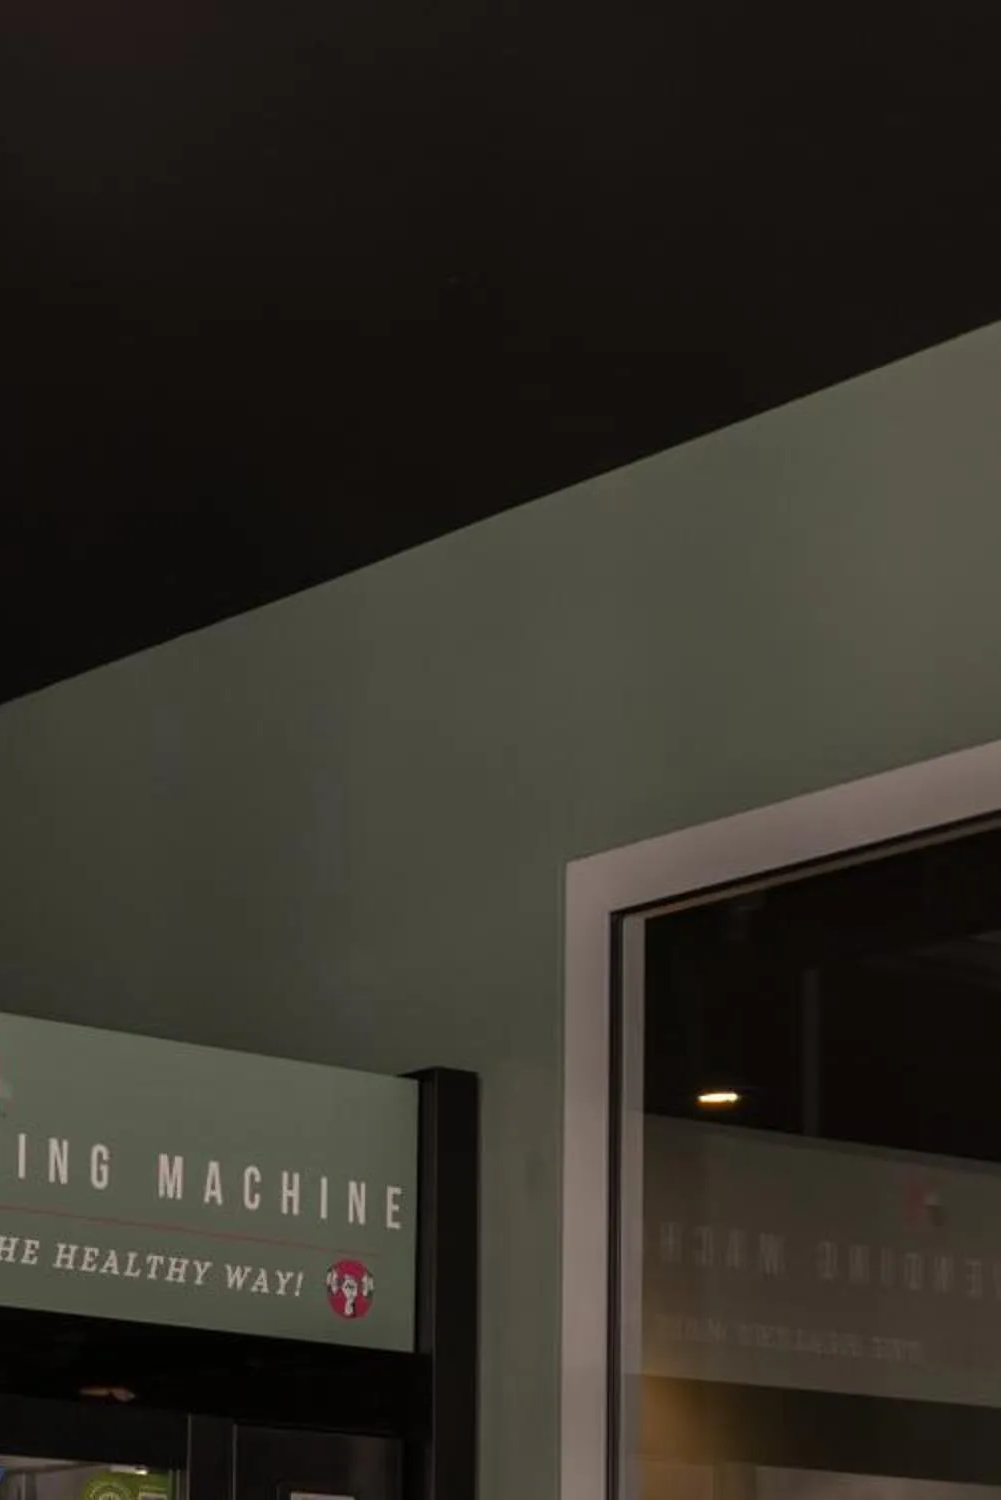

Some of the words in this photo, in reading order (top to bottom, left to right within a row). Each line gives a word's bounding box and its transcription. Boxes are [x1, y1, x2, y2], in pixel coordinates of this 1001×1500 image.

[157, 1152, 404, 1230] MACHINE
[53, 1242, 213, 1287] HEALTHY
[226, 1265, 305, 1298] WAY!
